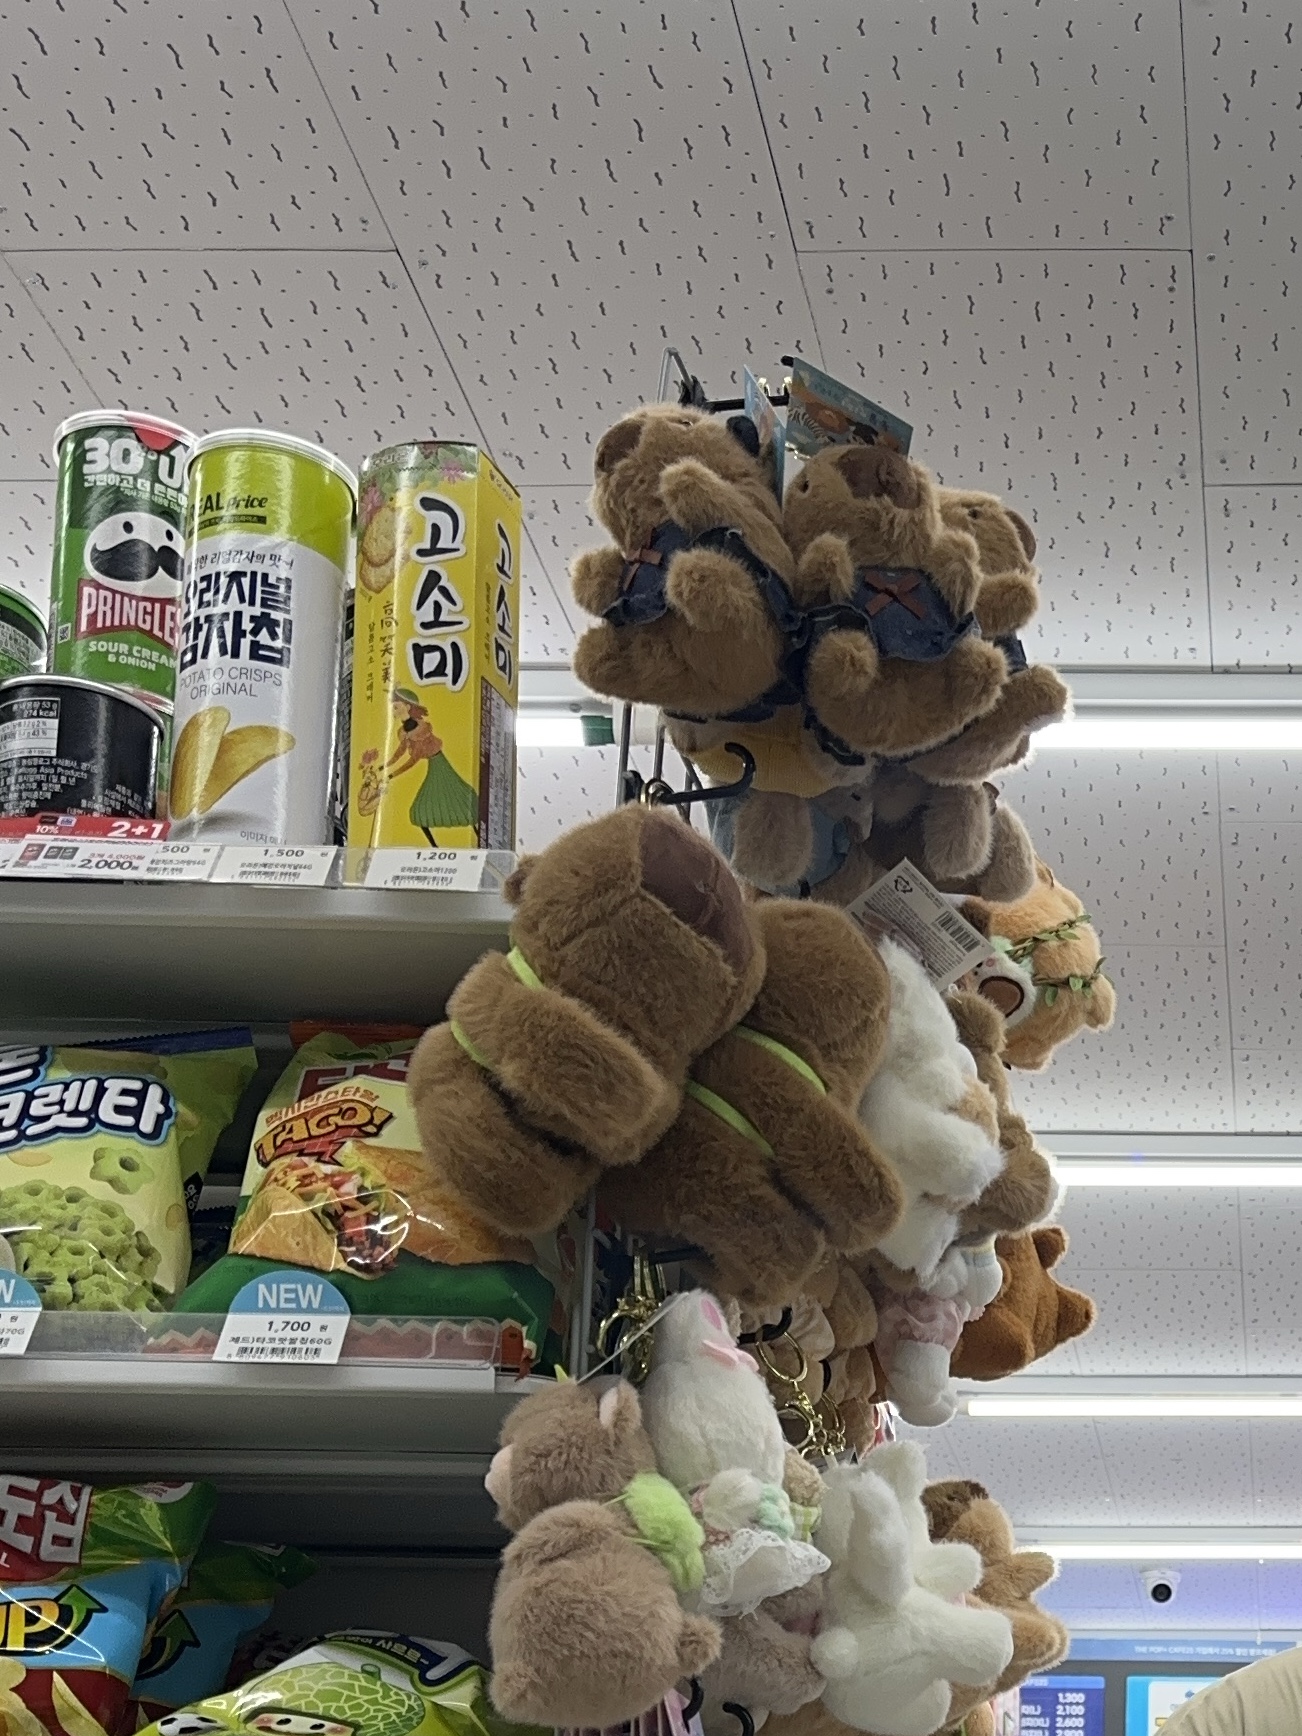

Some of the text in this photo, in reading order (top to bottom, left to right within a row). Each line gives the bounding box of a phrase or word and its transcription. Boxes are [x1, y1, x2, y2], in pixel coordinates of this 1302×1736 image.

[402, 494, 469, 688] 고소미
[89, 640, 129, 655] SOUR
[179, 610, 293, 674] 감자칩
[118, 654, 156, 671] ONION
[228, 666, 283, 687] CRISPS
[190, 682, 259, 700] ORIGINAL
[107, 821, 164, 839] 2+1
[254, 1098, 393, 1168] TACO!
[257, 1283, 323, 1309] NEW
[267, 1321, 311, 1333] 1,700
